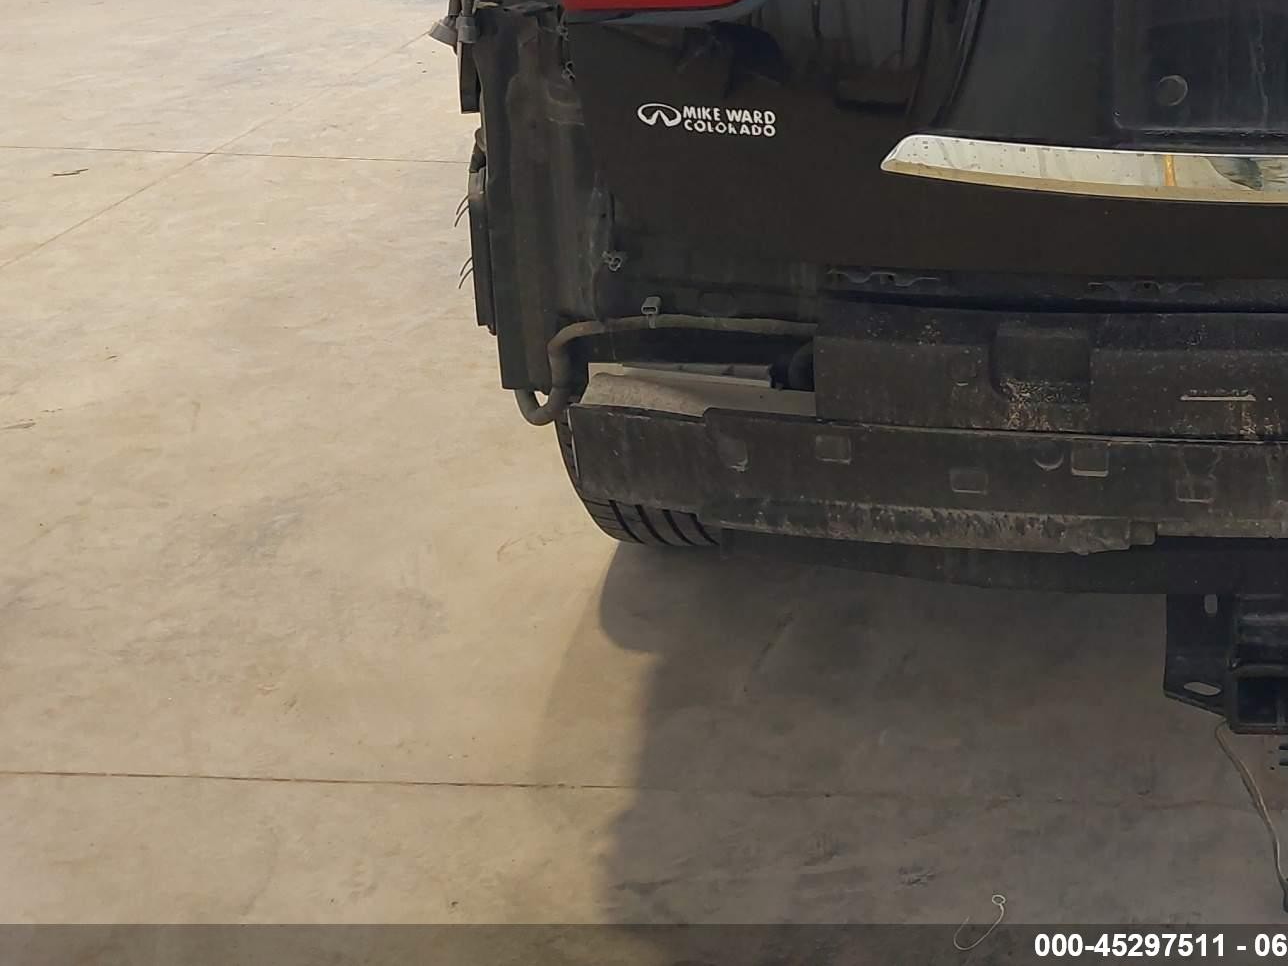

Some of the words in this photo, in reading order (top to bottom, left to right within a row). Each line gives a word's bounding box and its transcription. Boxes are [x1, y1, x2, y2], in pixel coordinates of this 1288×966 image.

[683, 105, 721, 122] MIKE
[725, 108, 776, 125] WARD
[683, 119, 776, 137] COLORADO
